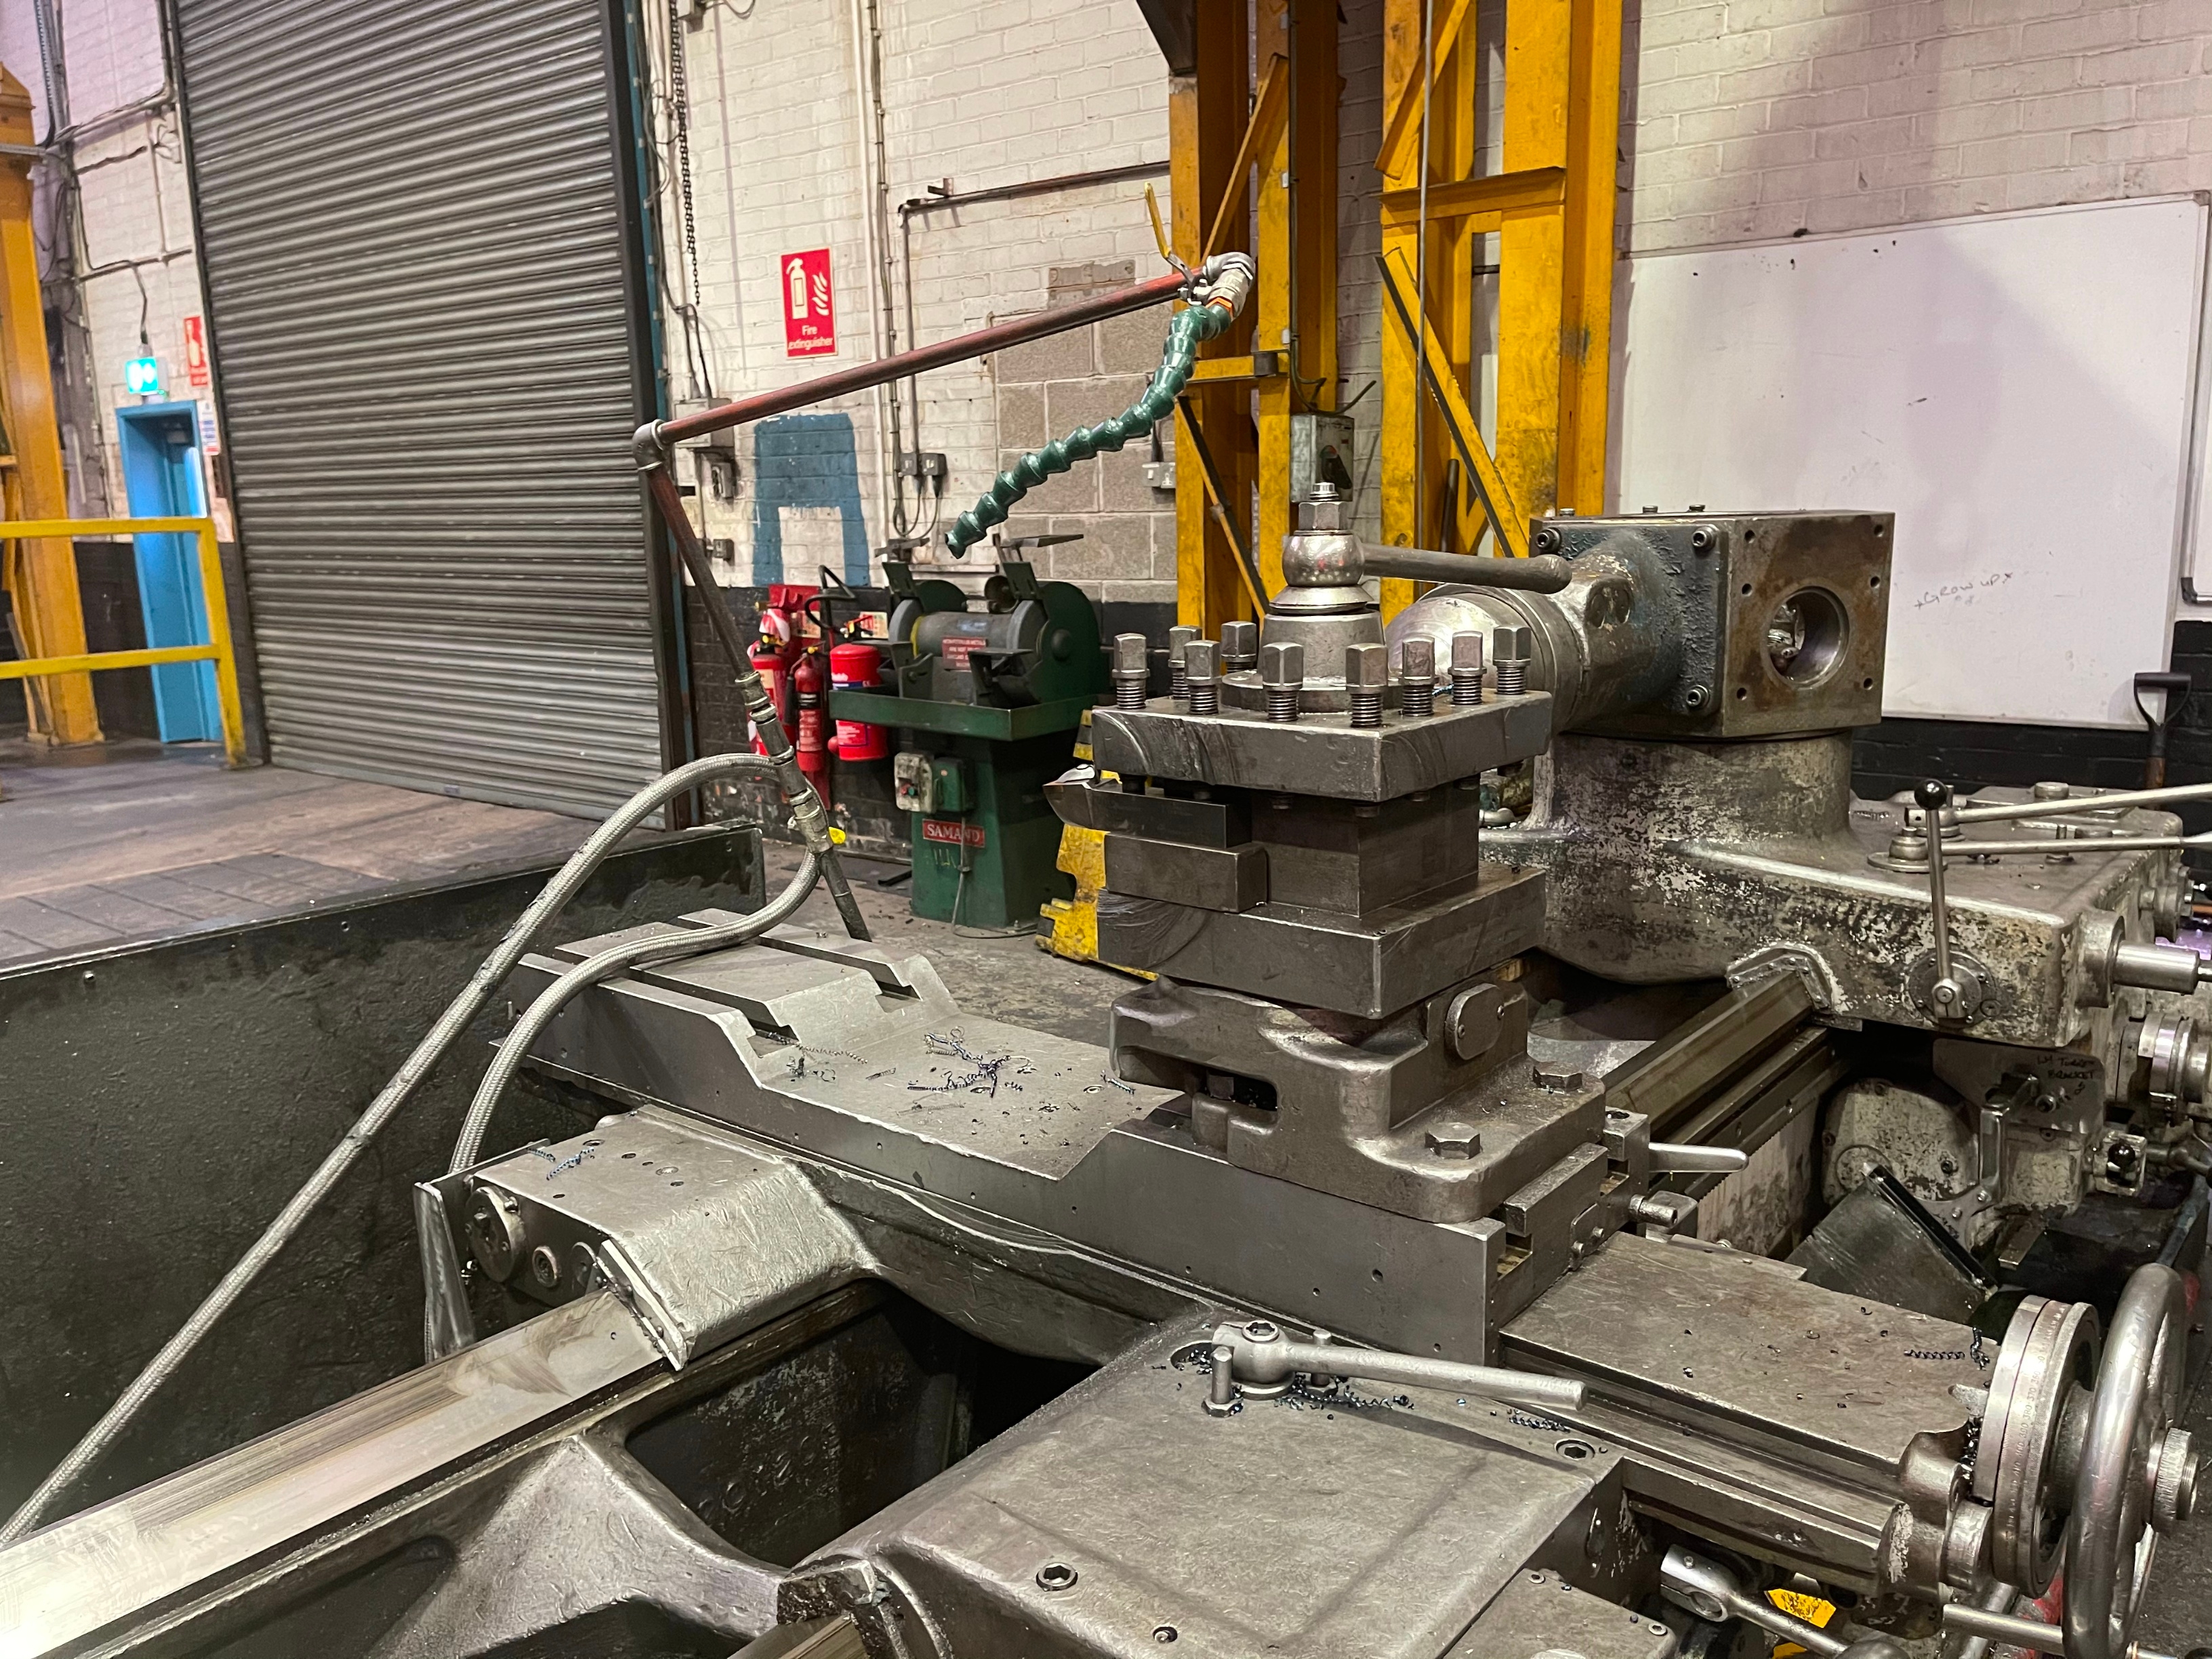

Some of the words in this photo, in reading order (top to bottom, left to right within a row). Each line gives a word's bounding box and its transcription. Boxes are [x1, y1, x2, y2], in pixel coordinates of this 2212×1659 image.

[802, 325, 817, 335] Fire
[788, 336, 833, 350] extinguisher
[926, 823, 980, 842] SAMAND
[2019, 1424, 2028, 1439] 390
[2026, 1387, 2037, 1402] 370
